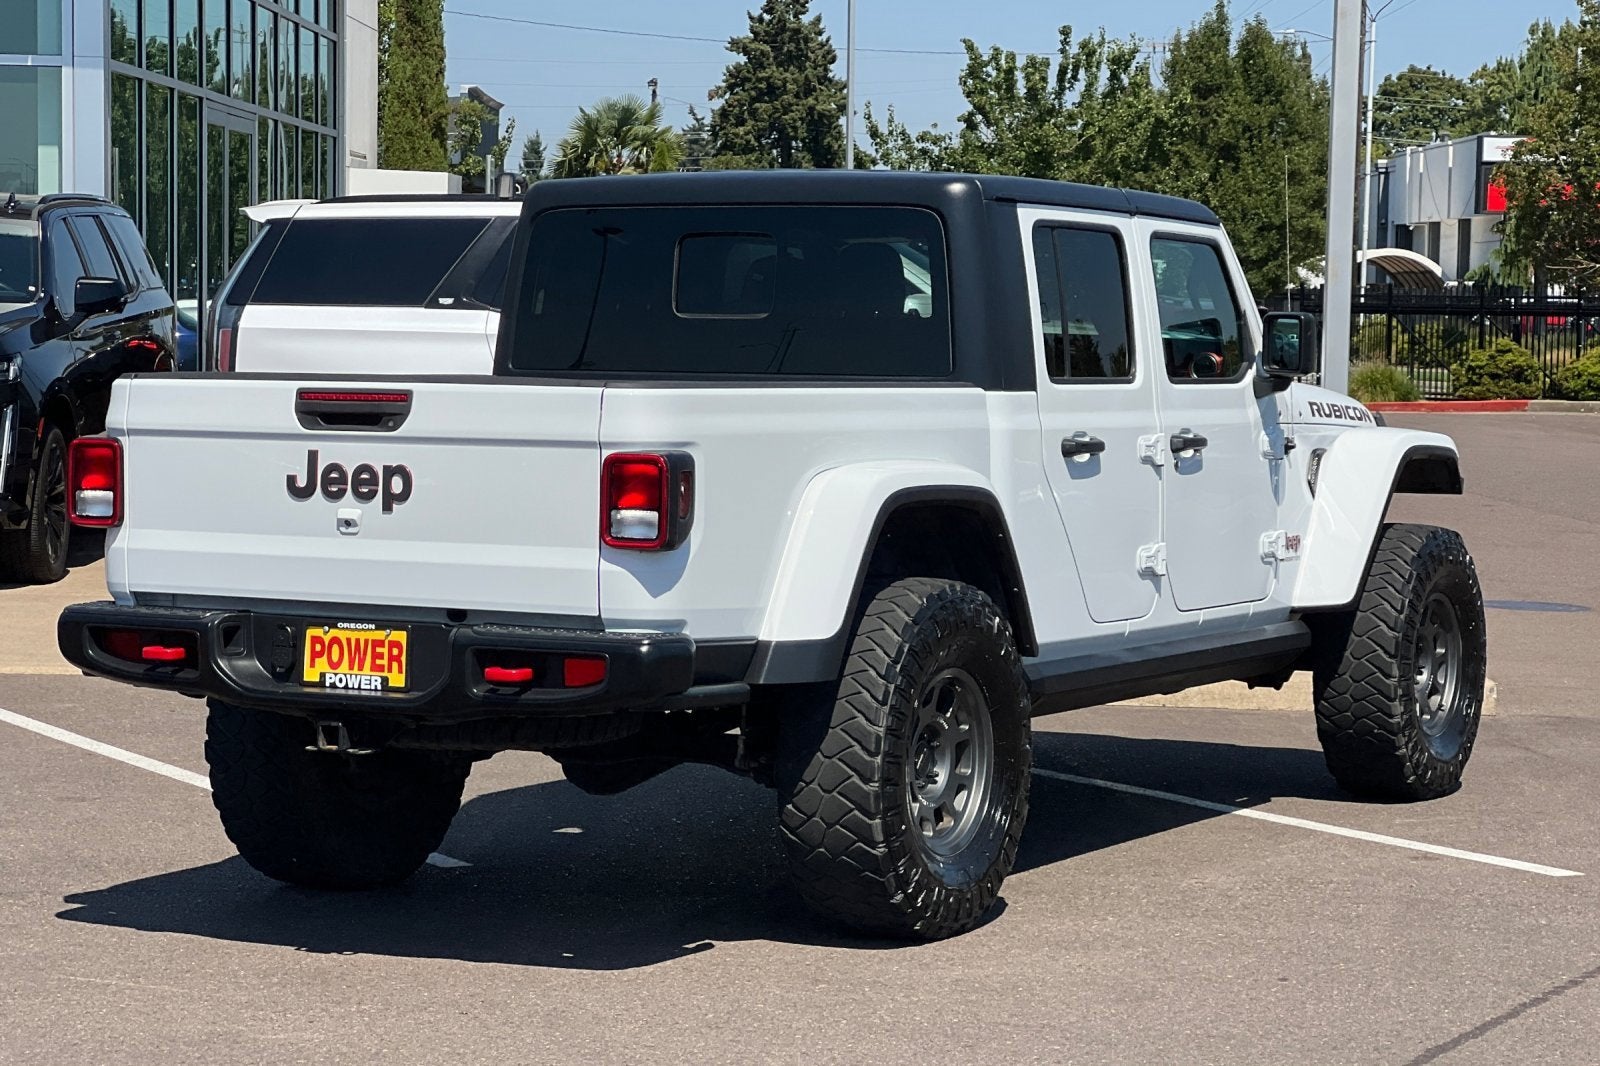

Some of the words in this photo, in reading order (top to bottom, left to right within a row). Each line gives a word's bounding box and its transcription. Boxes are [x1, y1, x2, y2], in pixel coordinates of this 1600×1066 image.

[1308, 401, 1373, 423] RUBICON
[286, 449, 413, 514] Jeep
[337, 622, 375, 630] OREGON
[309, 635, 404, 674] POWER
[325, 673, 382, 690] POWER
